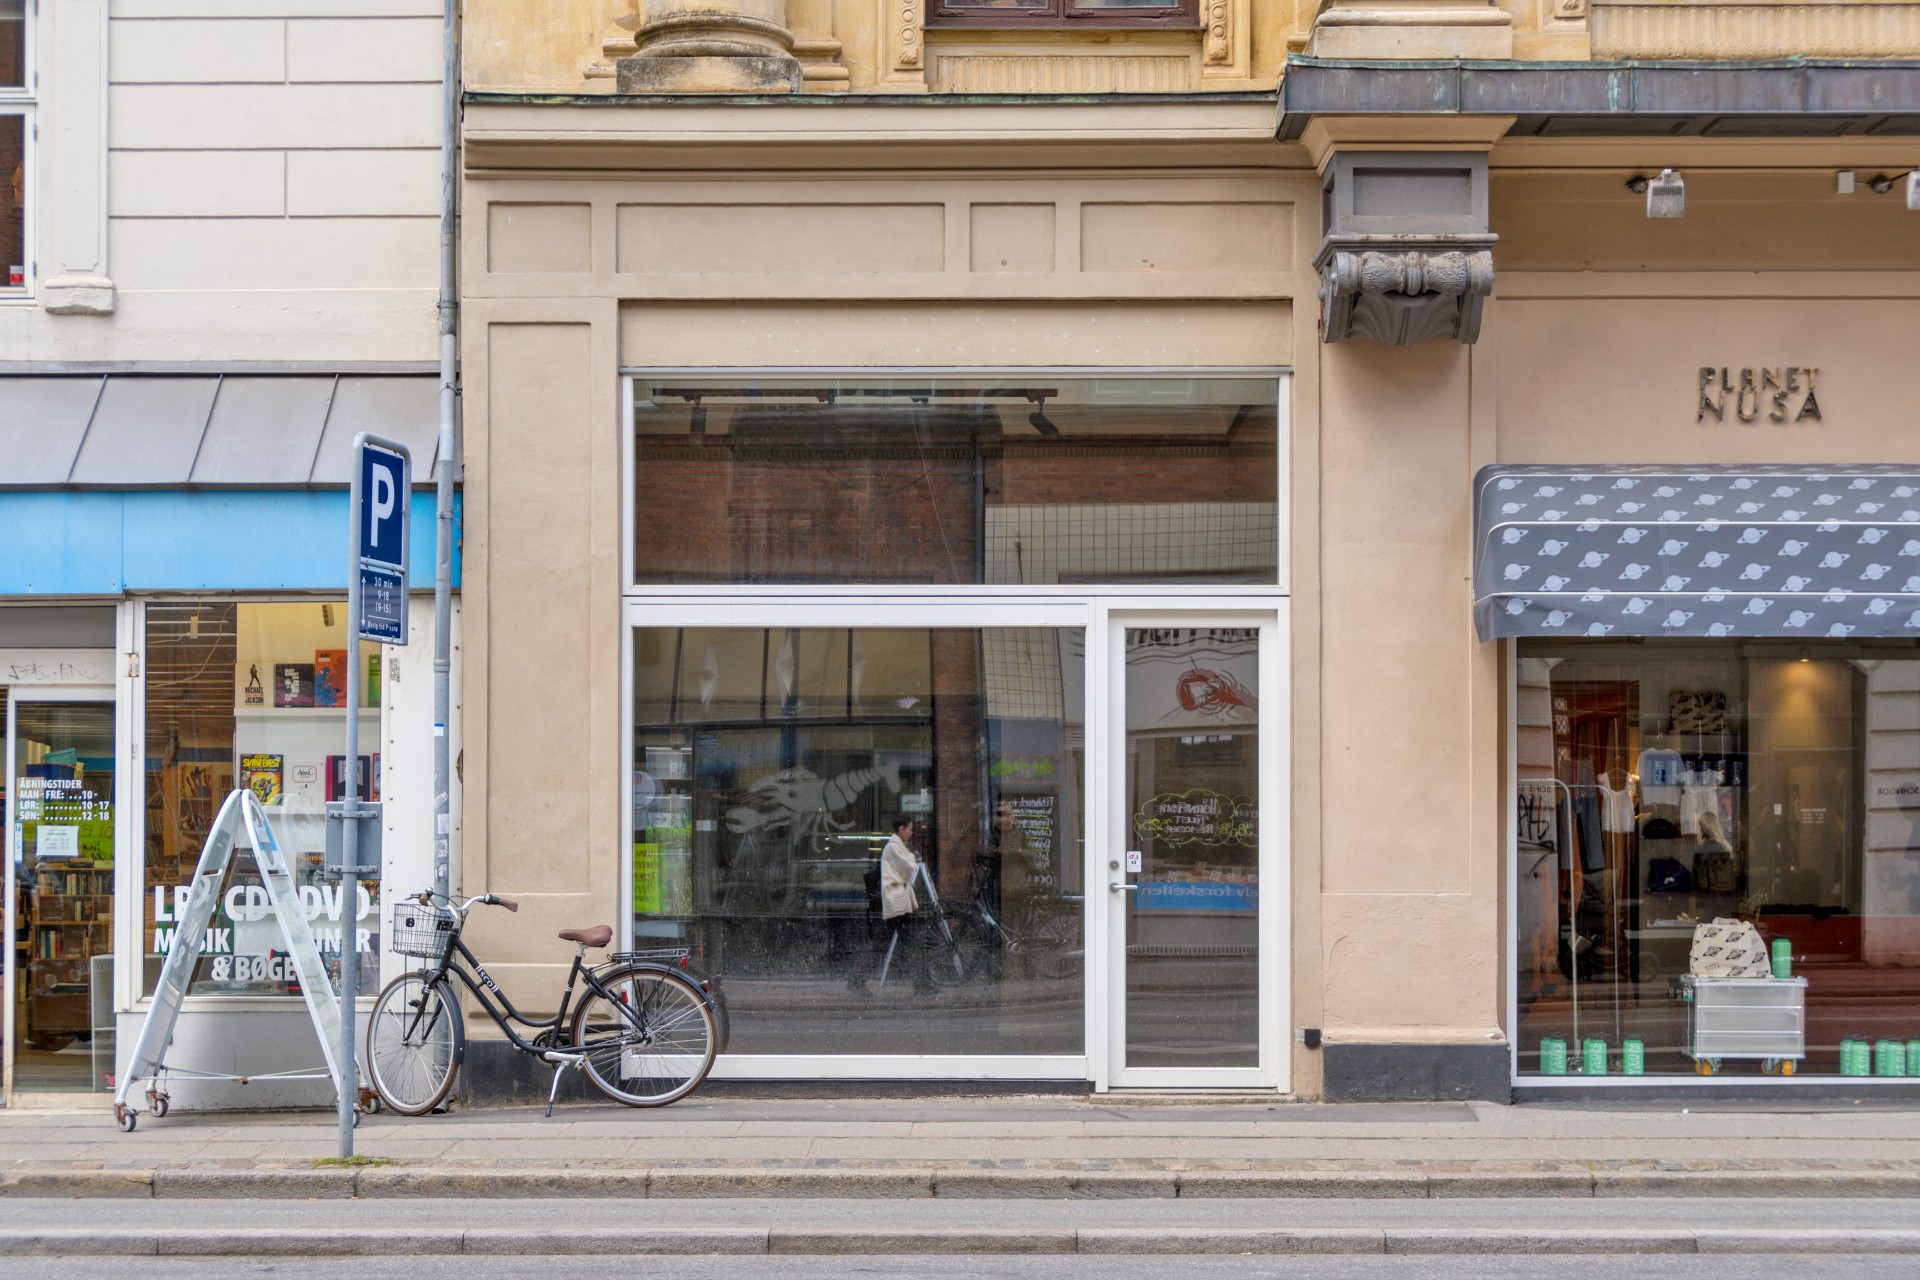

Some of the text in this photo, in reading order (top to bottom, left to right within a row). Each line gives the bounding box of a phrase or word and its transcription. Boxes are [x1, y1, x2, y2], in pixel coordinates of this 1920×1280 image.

[1699, 367, 1819, 391] PLANET
[1698, 390, 1822, 422] NUSA
[371, 462, 395, 548] P
[374, 576, 393, 589] 30 min
[20, 777, 82, 789] ÅBNINGSTIDER
[20, 790, 40, 799] MAN
[45, 790, 65, 799] FRE:
[20, 800, 39, 810] LØR:
[20, 811, 40, 820] SØN:
[153, 928, 231, 953] MIK
